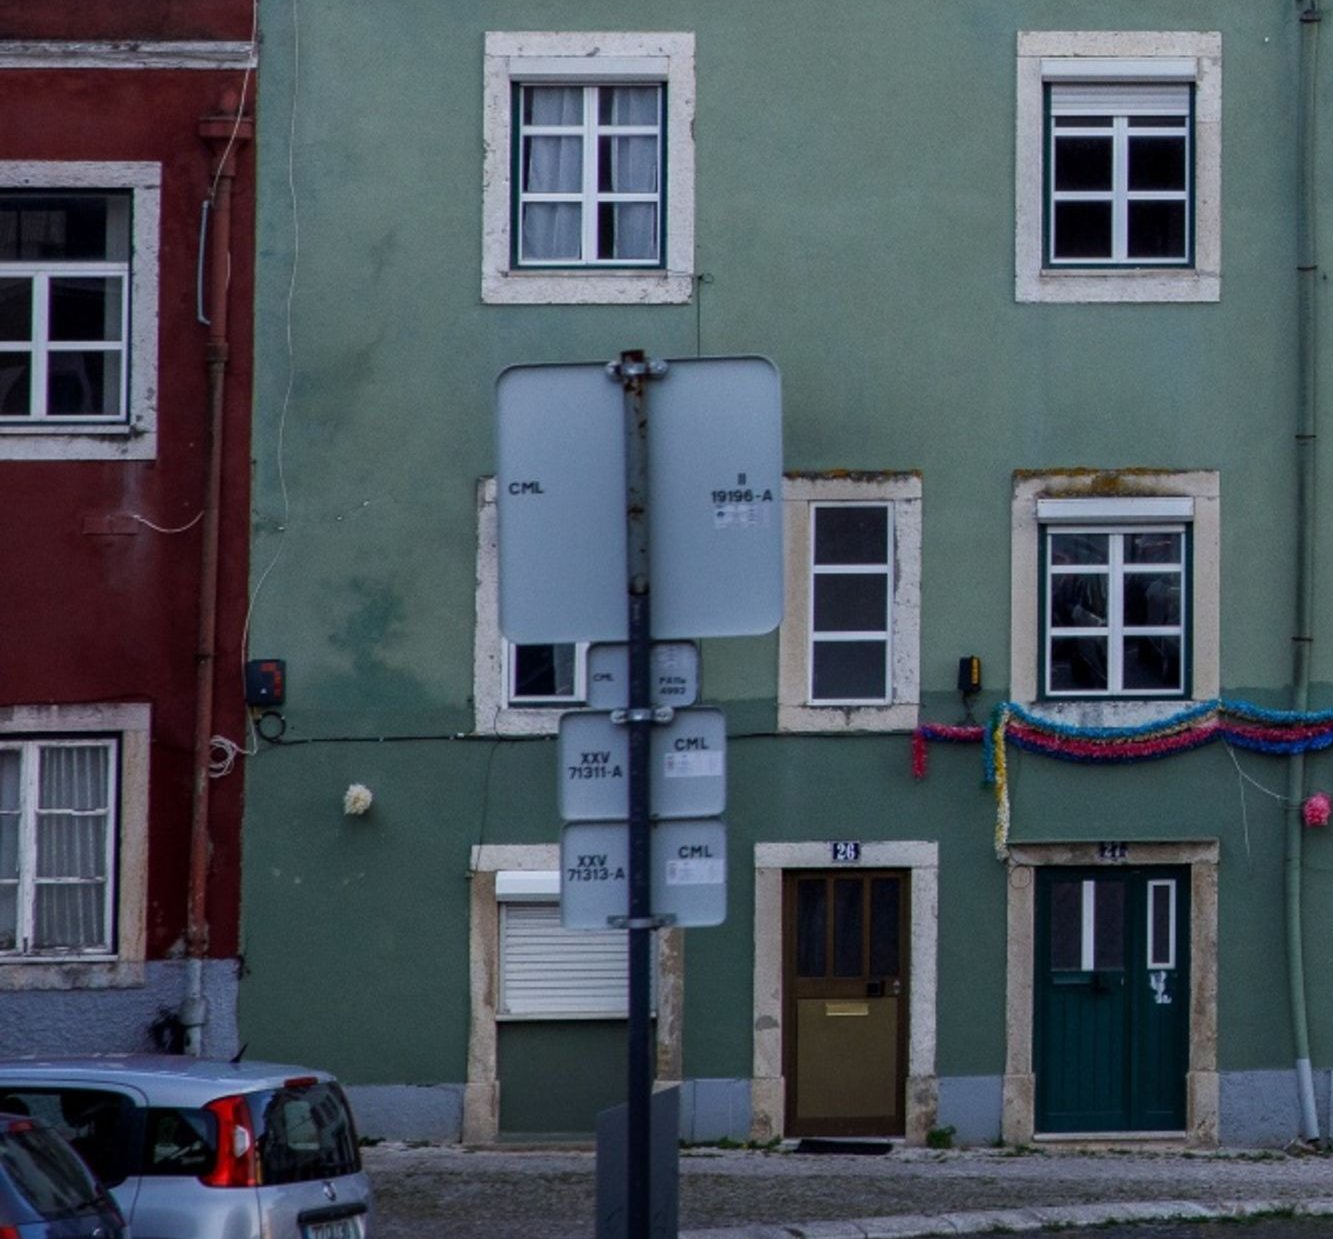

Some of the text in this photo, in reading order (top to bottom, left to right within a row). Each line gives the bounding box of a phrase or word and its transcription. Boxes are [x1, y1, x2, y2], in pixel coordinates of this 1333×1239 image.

[508, 482, 544, 495] CML
[711, 489, 773, 503] 19196-A
[674, 736, 710, 751] CML
[580, 751, 611, 765] XXV
[568, 765, 623, 779] 71311-A
[678, 844, 713, 859] CML
[836, 842, 856, 860] 26
[577, 854, 608, 868] XXV
[567, 867, 626, 882] 71313-A
